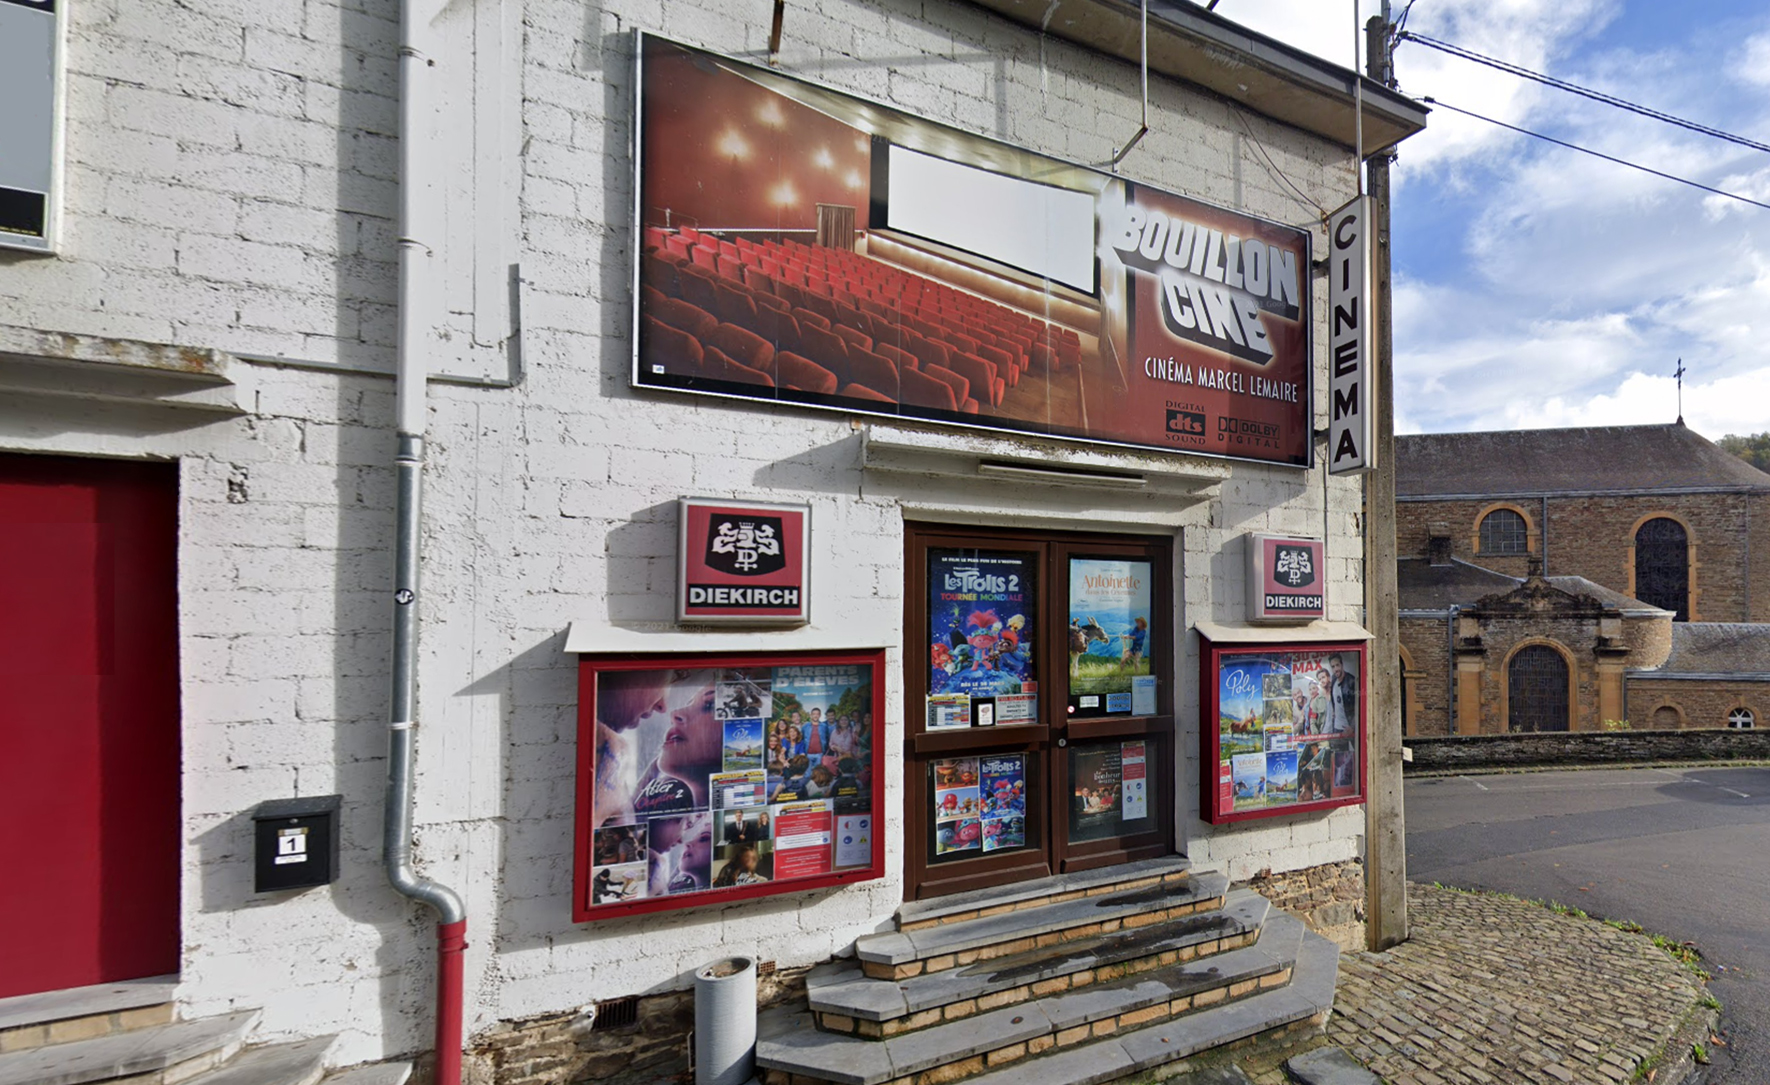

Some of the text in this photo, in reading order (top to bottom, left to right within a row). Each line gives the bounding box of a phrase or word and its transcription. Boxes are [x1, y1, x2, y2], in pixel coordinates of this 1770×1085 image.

[1113, 204, 1299, 309] BOUILLON
[1334, 214, 1359, 464] CINEMA
[1145, 355, 1298, 403] CINÉMA MARCEL LEMAIRE
[1165, 400, 1206, 414] DIGITAL
[1168, 414, 1204, 435] dts
[1241, 422, 1279, 437] DOLBY
[1165, 433, 1206, 446] SOUND
[1217, 430, 1281, 450] DIGITAL
[1008, 574, 1020, 592] 2
[1081, 574, 1141, 591] Antoinette
[689, 587, 800, 605] DIEKIRCH
[940, 592, 1024, 602] TOURNÉE MONDIALE
[1265, 595, 1322, 608] DIEKIRCH
[778, 665, 858, 678] PARENTS
[1292, 658, 1323, 676] MAX
[1226, 669, 1260, 702] Poly
[675, 789, 684, 799] 2
[286, 837, 296, 852] 1
